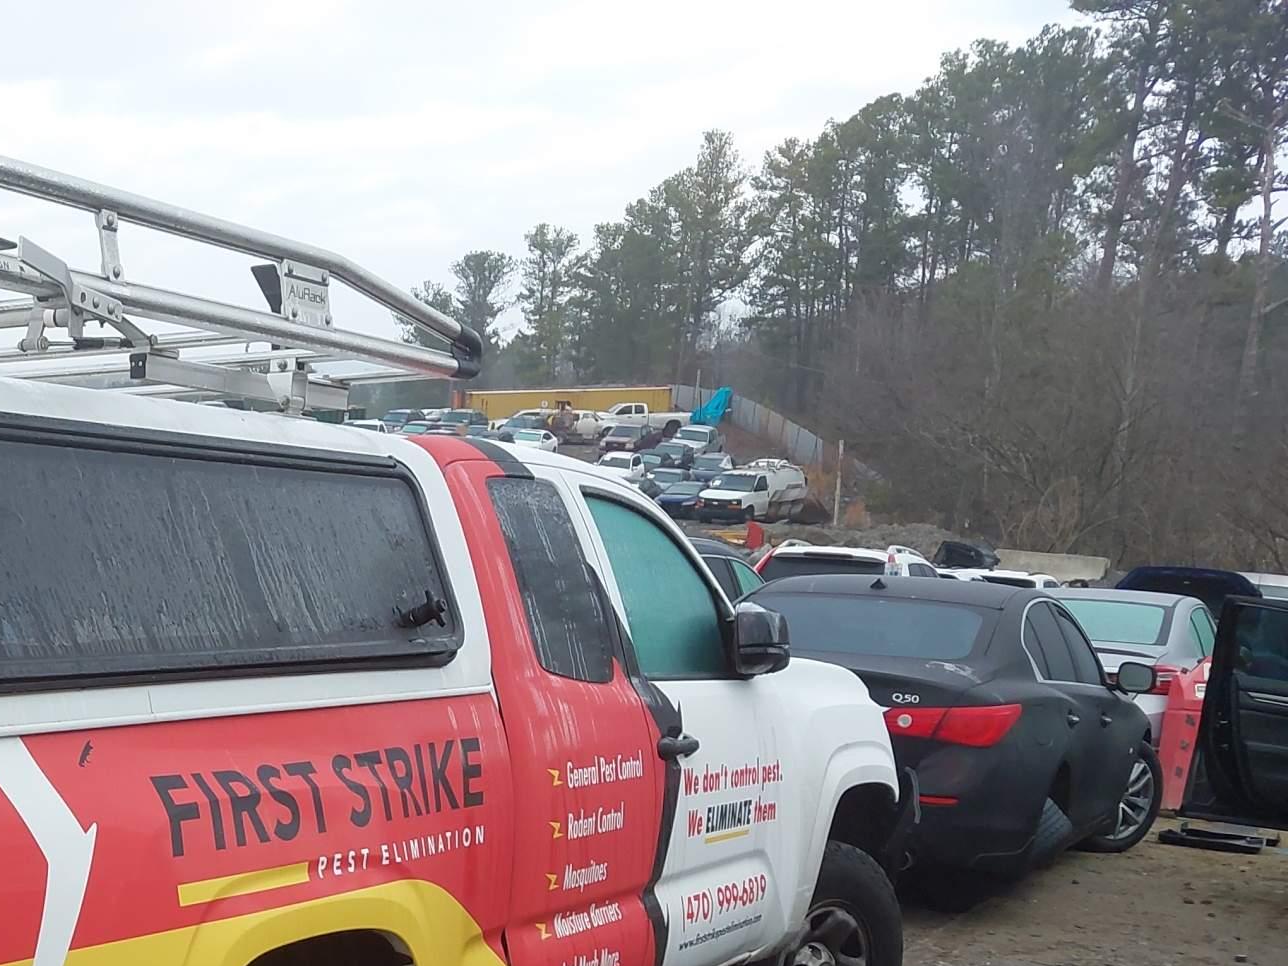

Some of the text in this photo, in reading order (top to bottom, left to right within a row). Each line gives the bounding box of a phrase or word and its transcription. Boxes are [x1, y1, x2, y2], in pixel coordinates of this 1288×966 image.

[892, 692, 920, 704] Q50
[567, 748, 643, 789] General Pest Control
[684, 757, 783, 796] We don't control pest.
[150, 737, 485, 858] FIRST STRIKE
[688, 795, 777, 838] We ELIMINATE them
[568, 801, 624, 840] Rodent Control
[317, 825, 486, 879] PEST ELIMINATION
[563, 859, 608, 893] Mosquitoes
[554, 901, 623, 939] Moisture Barriers
[680, 887, 714, 933] (470)
[717, 873, 767, 915] 999-6819
